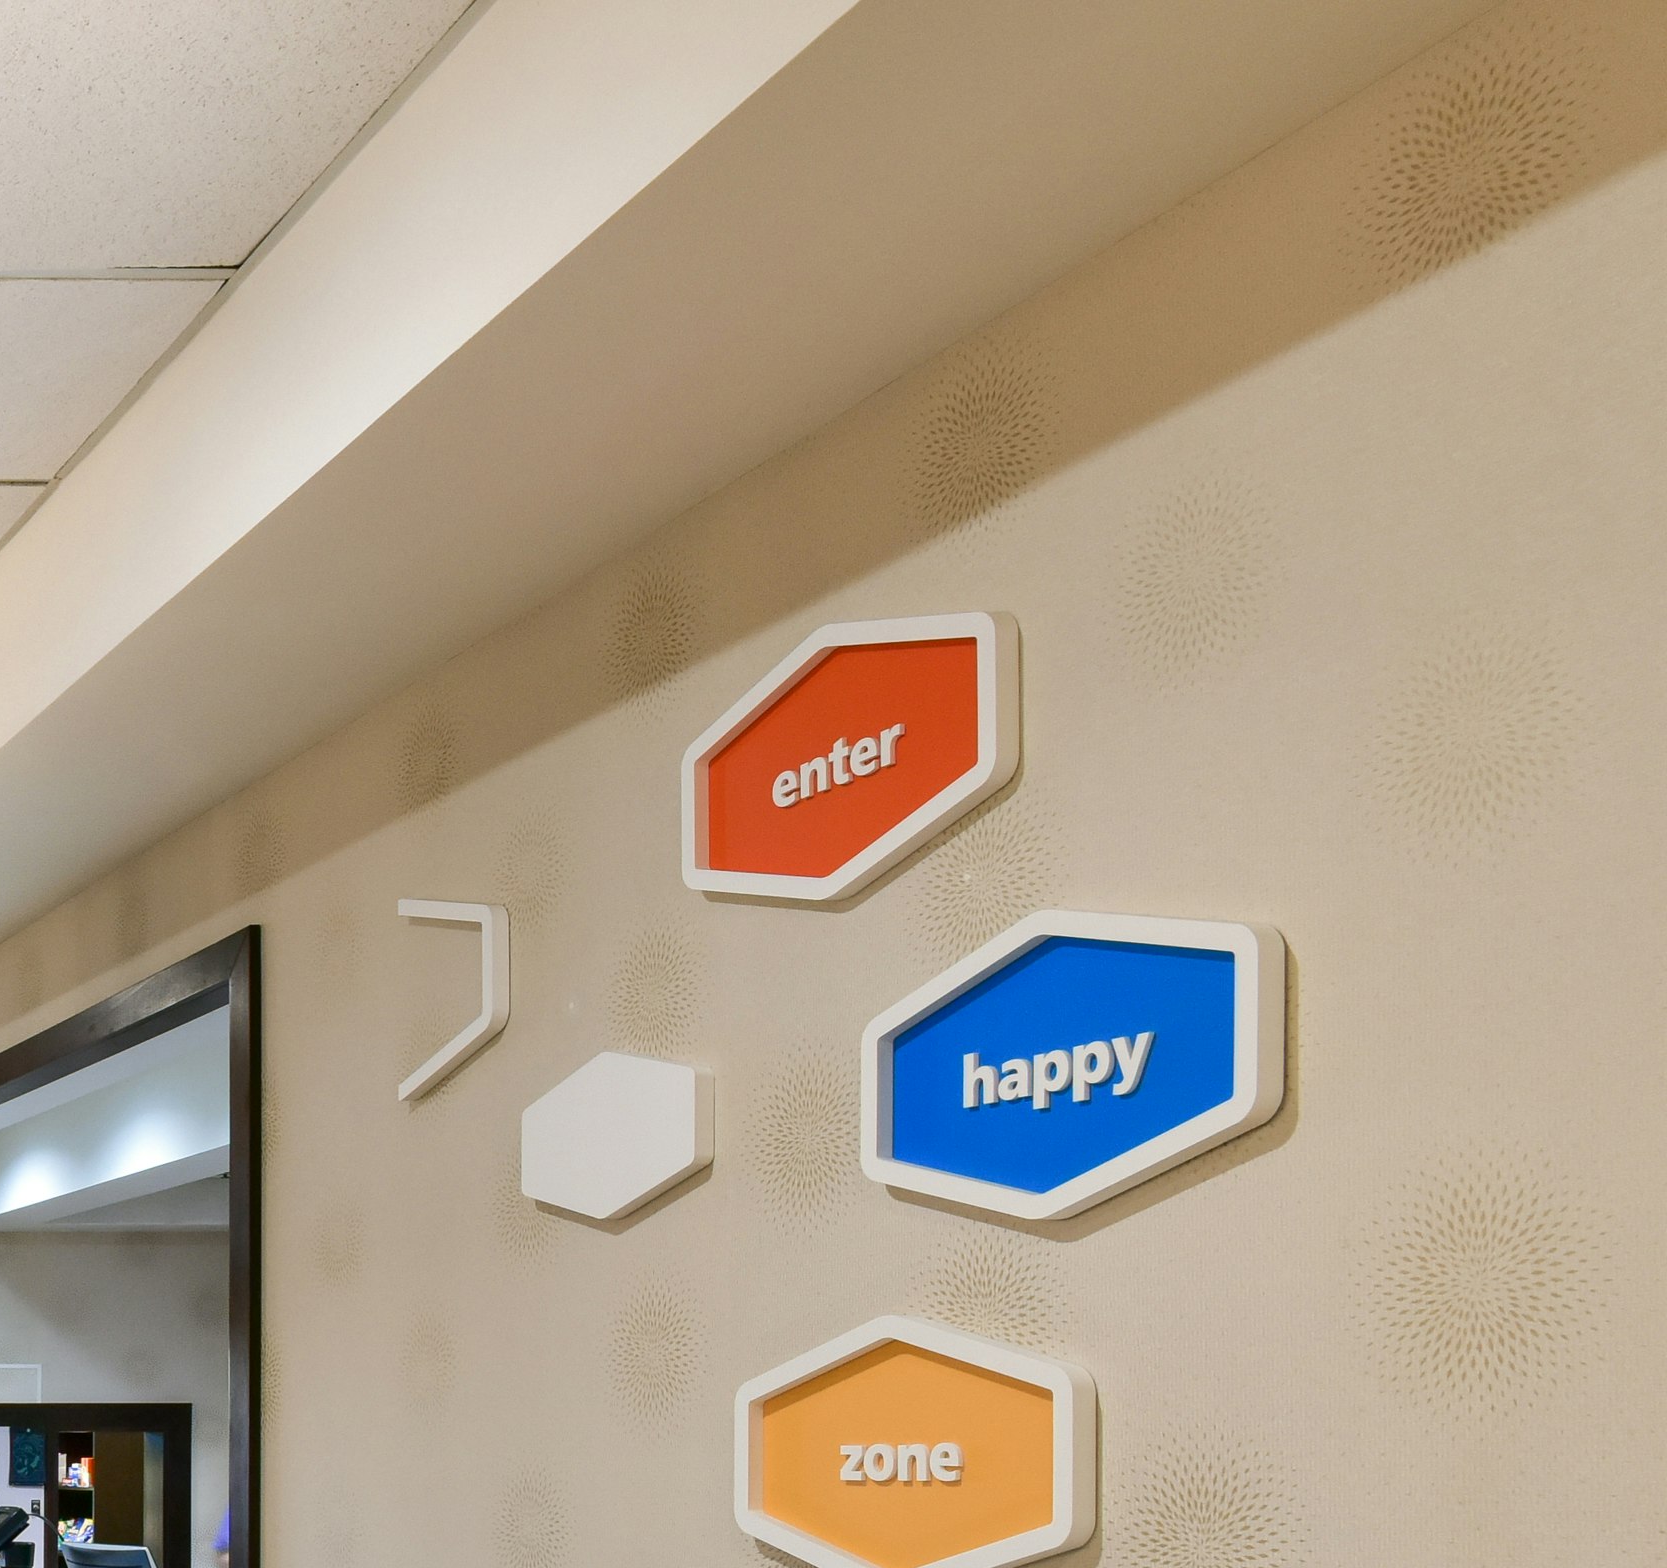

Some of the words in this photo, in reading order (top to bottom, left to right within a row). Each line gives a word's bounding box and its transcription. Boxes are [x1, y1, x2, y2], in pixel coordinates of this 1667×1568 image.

[772, 723, 906, 808] enter
[963, 1031, 1155, 1110] happy
[840, 1442, 964, 1483] zone
